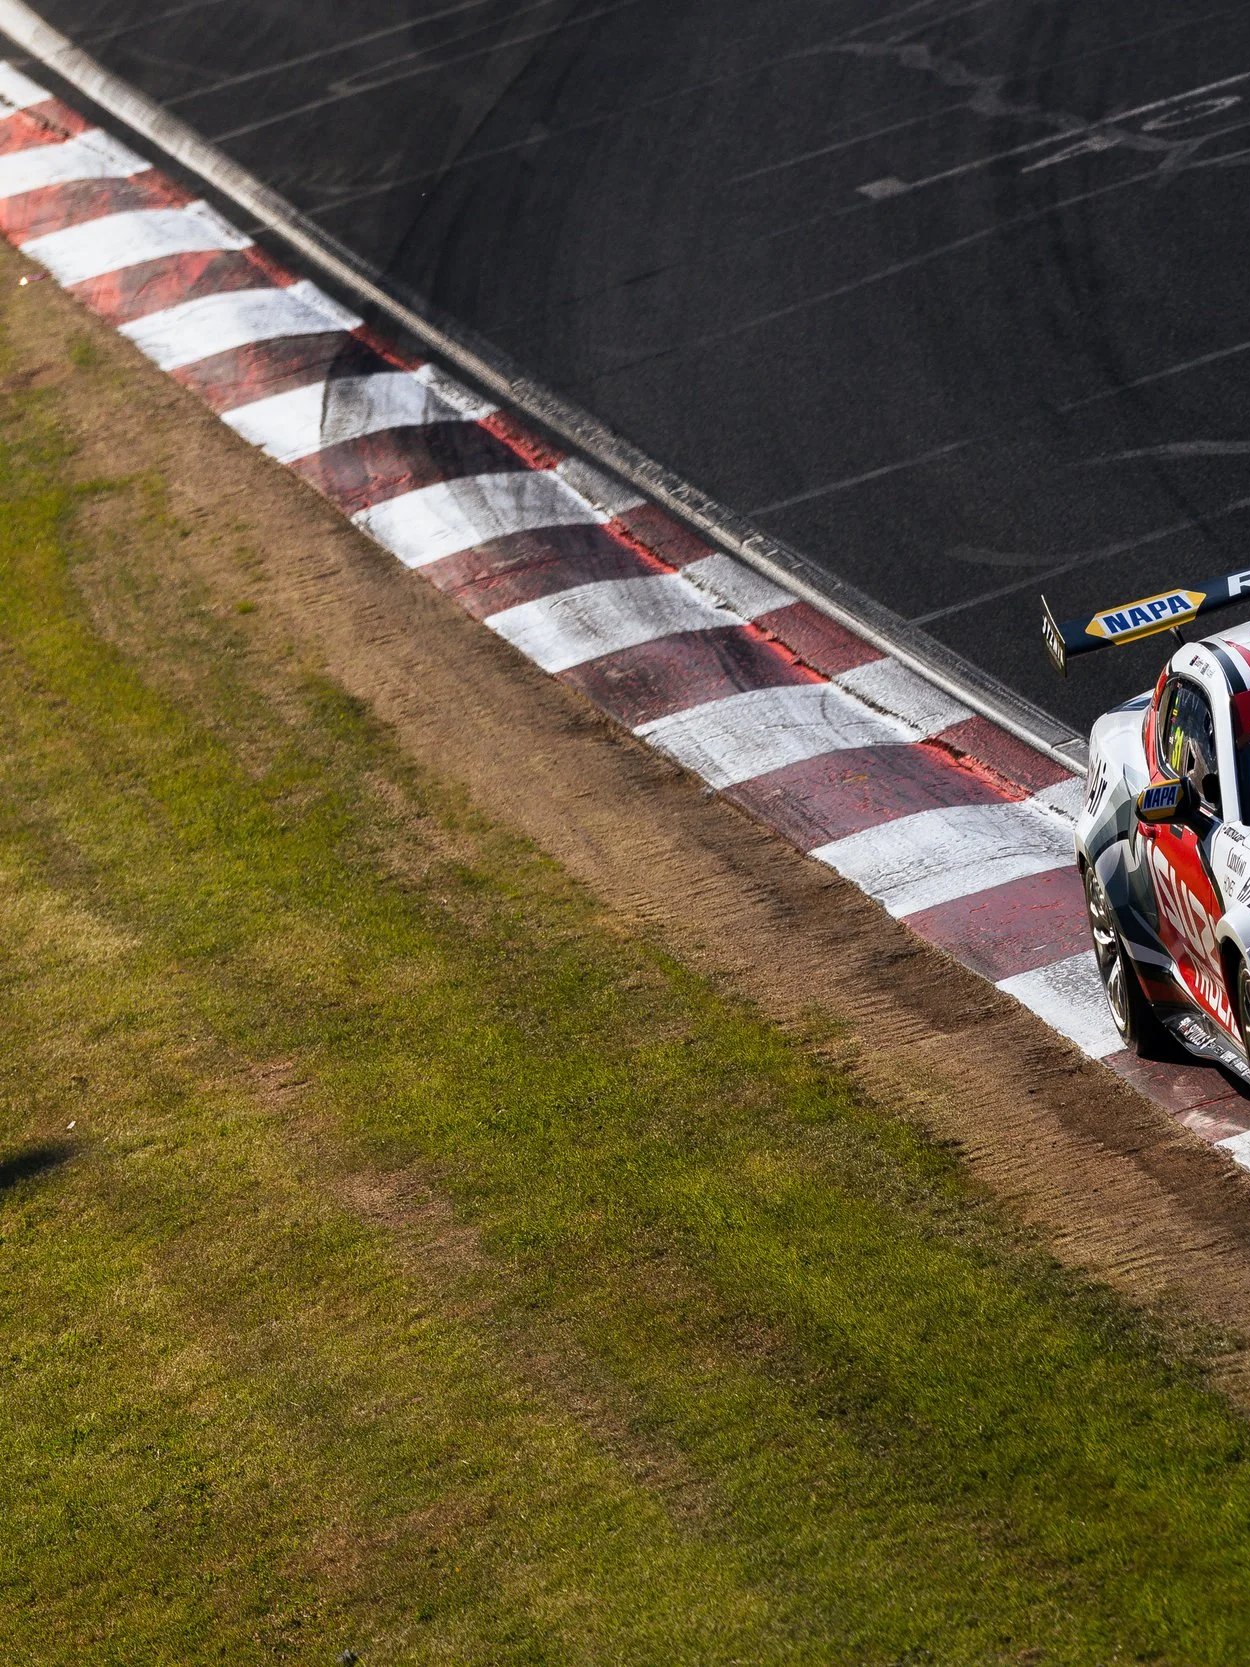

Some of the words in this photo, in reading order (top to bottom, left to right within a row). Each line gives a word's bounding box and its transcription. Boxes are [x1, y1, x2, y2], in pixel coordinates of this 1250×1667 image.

[1102, 595, 1192, 634] NAPA
[1143, 786, 1177, 809] NAPA
[1147, 839, 1224, 981] ISUZ
